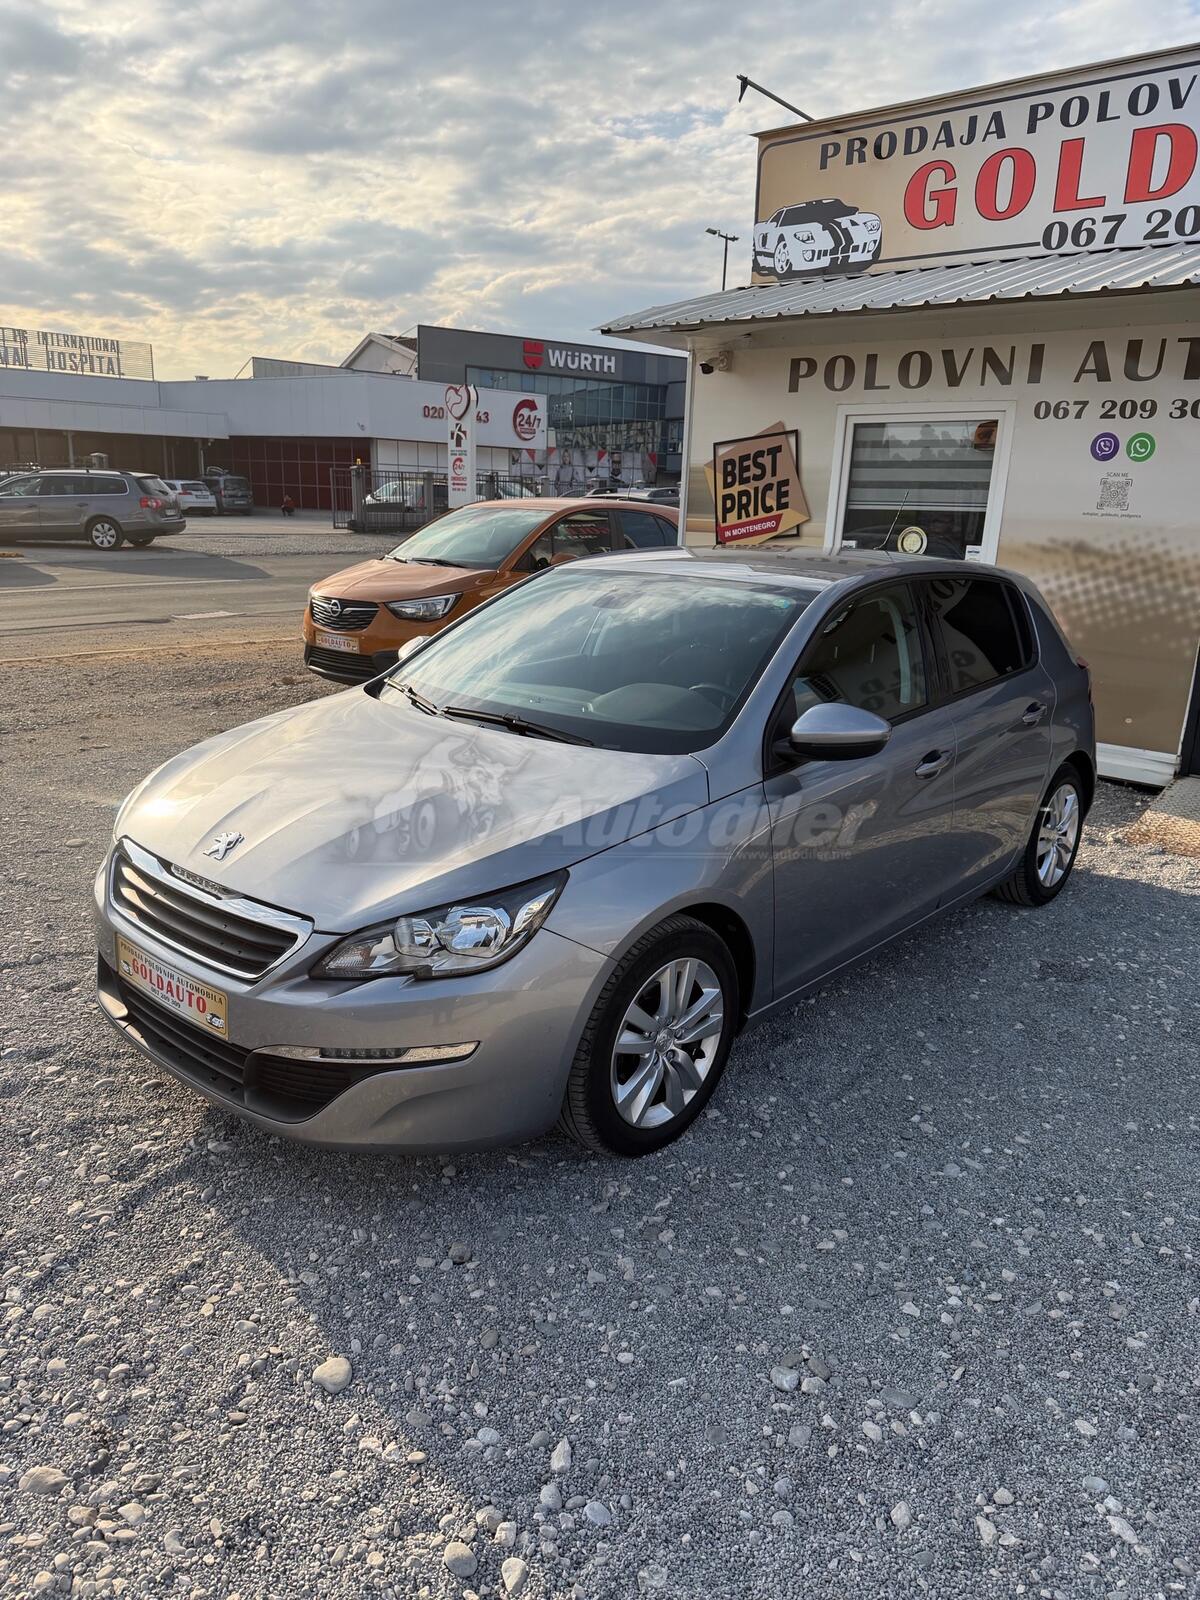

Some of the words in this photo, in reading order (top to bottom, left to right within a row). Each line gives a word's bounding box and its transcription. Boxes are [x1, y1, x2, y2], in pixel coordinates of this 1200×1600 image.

[819, 111, 1006, 170] PRODAJA
[1027, 75, 1198, 134] POLOV
[903, 123, 1198, 231] GOLD
[1042, 214, 1127, 250] 067
[1143, 205, 1200, 241] 20
[47, 350, 124, 376] HOSPITAL
[788, 343, 1046, 393] POLOVNI
[423, 405, 445, 420] 020
[518, 413, 542, 429] 24/7
[1034, 400, 1089, 420] 067
[1099, 399, 1158, 420] 209
[723, 445, 782, 490] BEST
[722, 478, 790, 524] PRICE
[725, 530, 732, 538] IN
[732, 520, 777, 537] MONTENEGRO
[132, 958, 207, 1014] GOLDAUTO
[176, 976, 223, 1006] AUTOMOBILA
